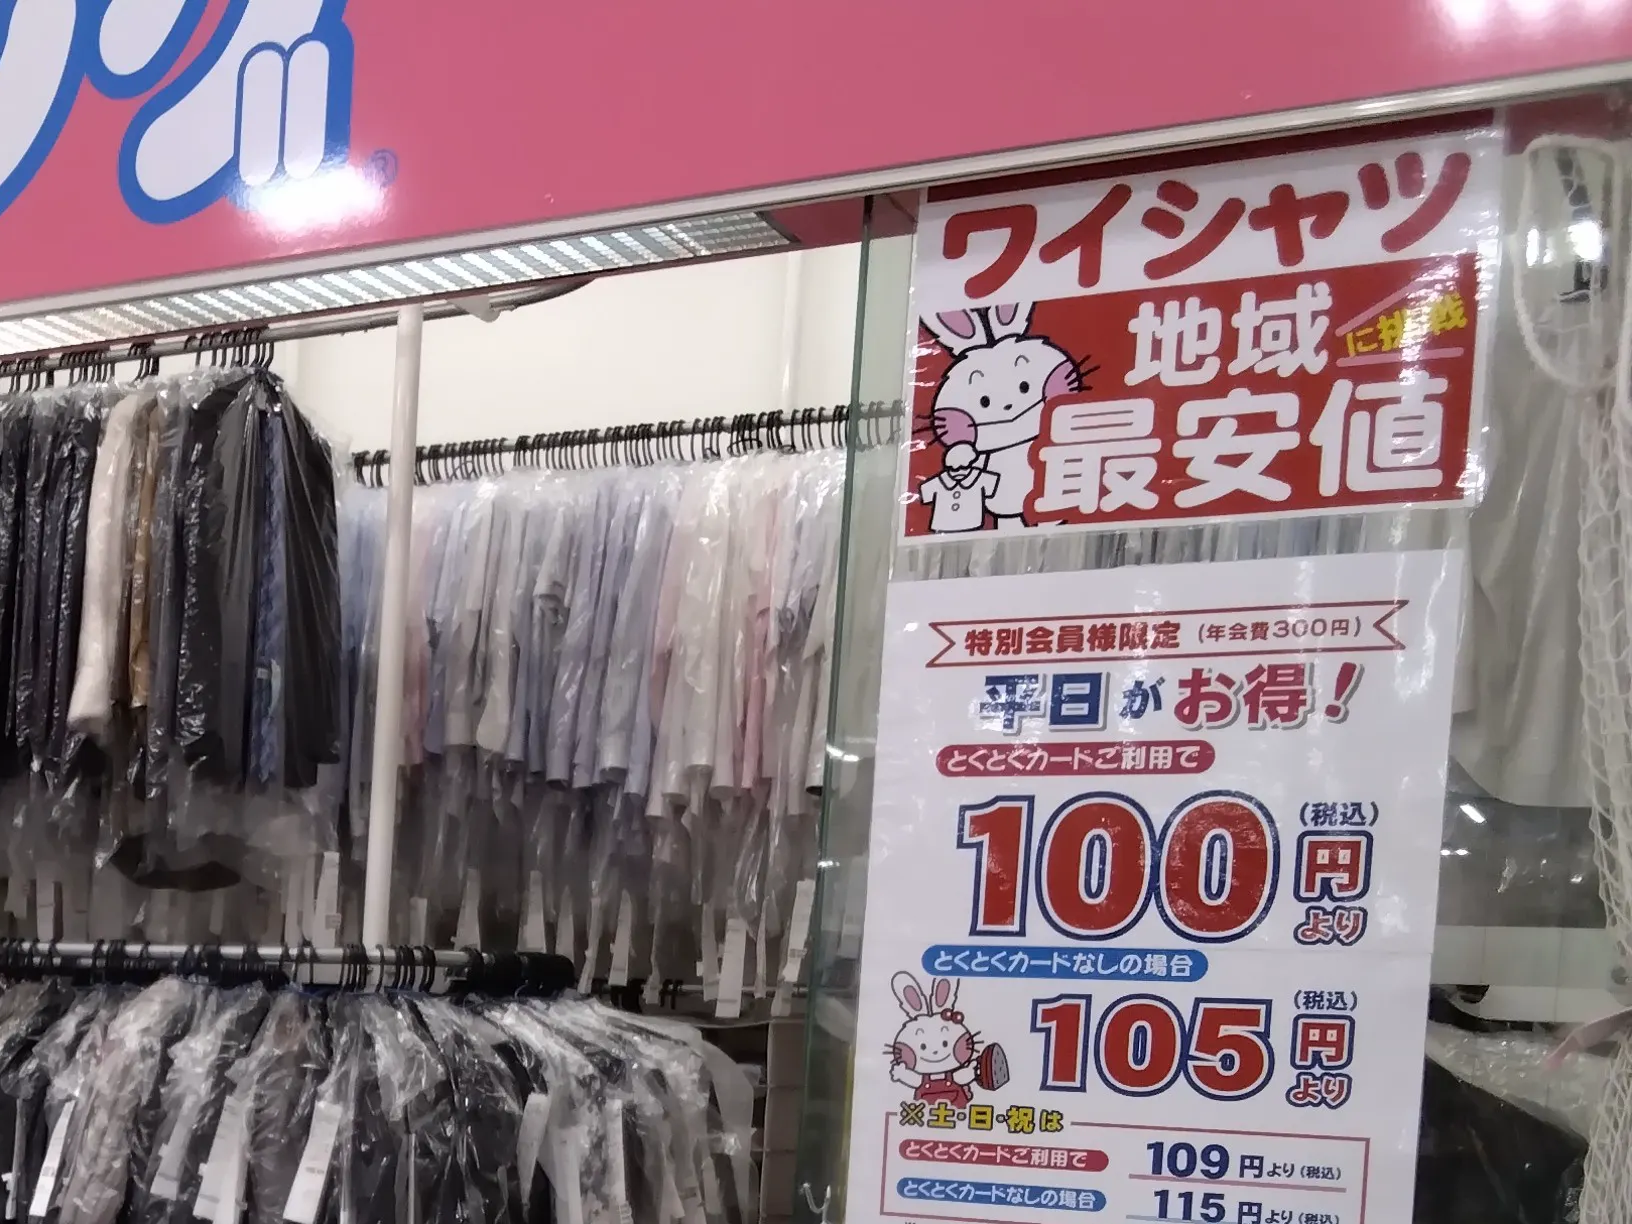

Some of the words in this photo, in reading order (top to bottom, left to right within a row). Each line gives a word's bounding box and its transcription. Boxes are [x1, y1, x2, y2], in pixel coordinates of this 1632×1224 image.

[942, 151, 1472, 299] ワイシャツ
[1126, 283, 1334, 387] 地域
[1033, 376, 1449, 515] 最安値
[964, 621, 1182, 656] 特別会員様限定
[945, 742, 1201, 773] とくとくカードご利用で
[956, 790, 1280, 943] 100
[1292, 830, 1374, 902] 円
[1292, 905, 1368, 946] より
[934, 950, 1194, 978] とくとくカードなしの場合
[1030, 993, 1275, 1101] 105
[1289, 1013, 1355, 1071] 円
[1285, 1072, 1353, 1109] より
[904, 1141, 1088, 1169] とくとくカードご利用で
[902, 1180, 1096, 1209] とくとくカードなしの場合
